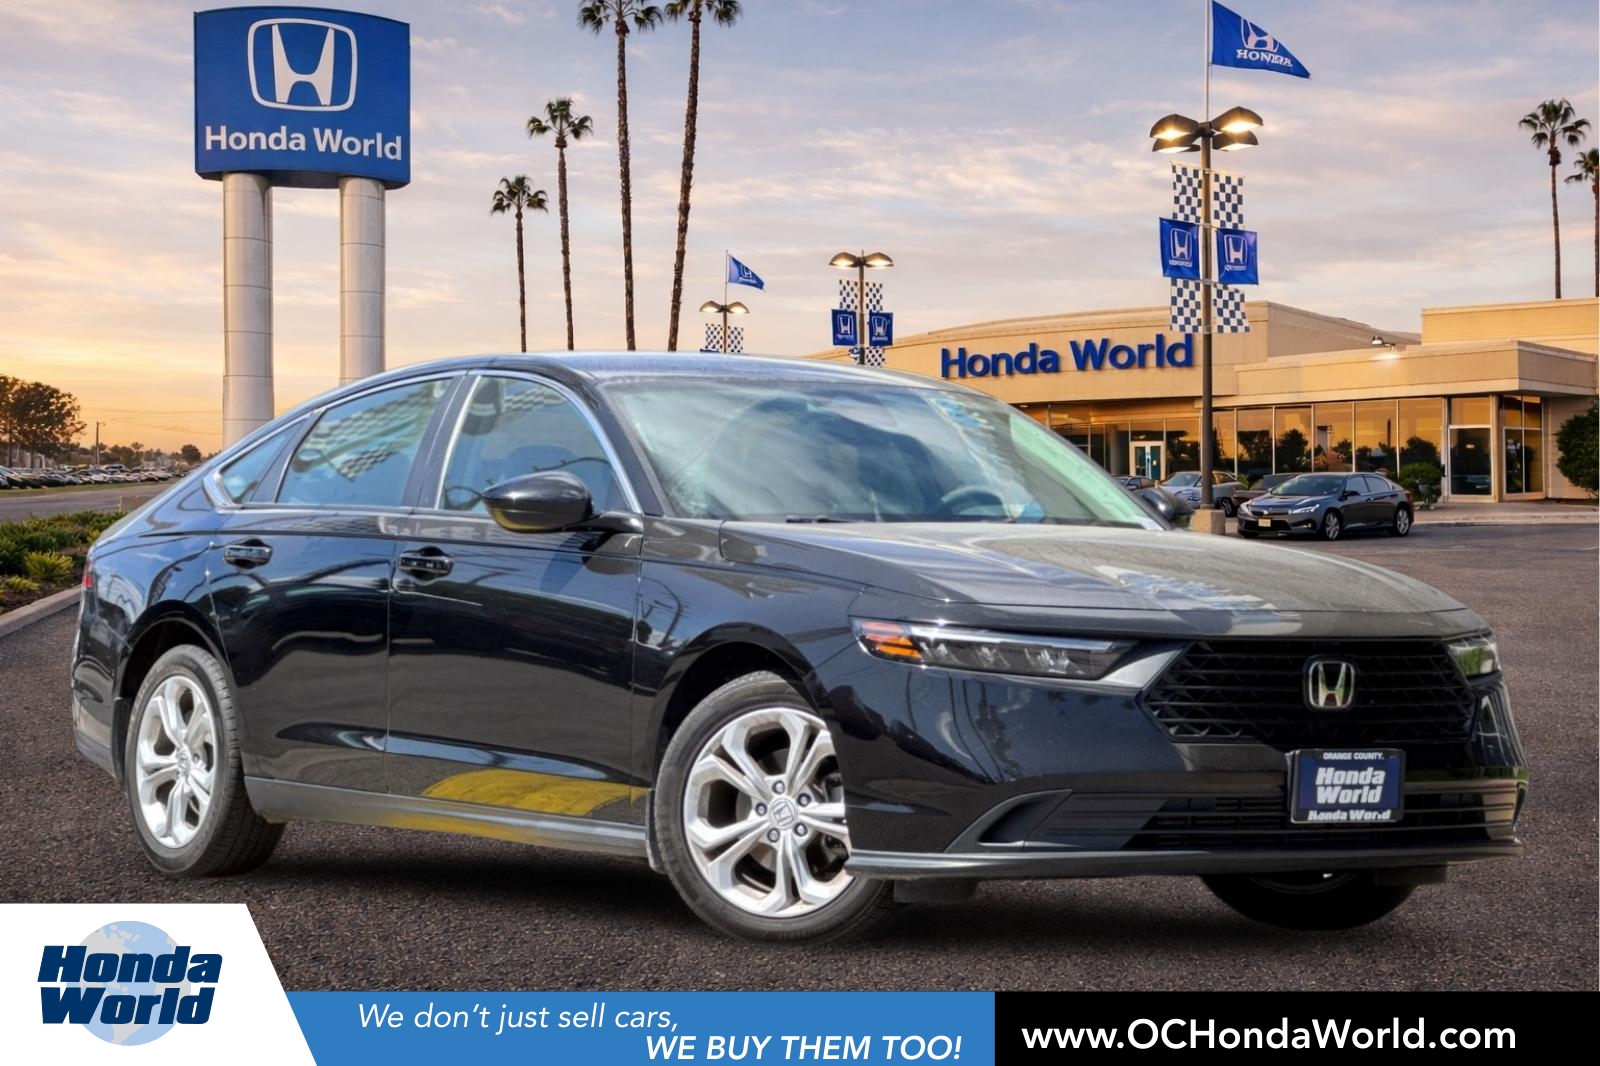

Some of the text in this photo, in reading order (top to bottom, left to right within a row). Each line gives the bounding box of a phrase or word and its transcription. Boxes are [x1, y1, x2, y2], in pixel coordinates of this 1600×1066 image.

[205, 125, 402, 161] Honda World
[941, 333, 1194, 378] Honda World
[1323, 752, 1352, 760] ORANGE
[1315, 767, 1386, 785] Honda
[1316, 785, 1383, 804] World
[1307, 810, 1348, 821] Honda
